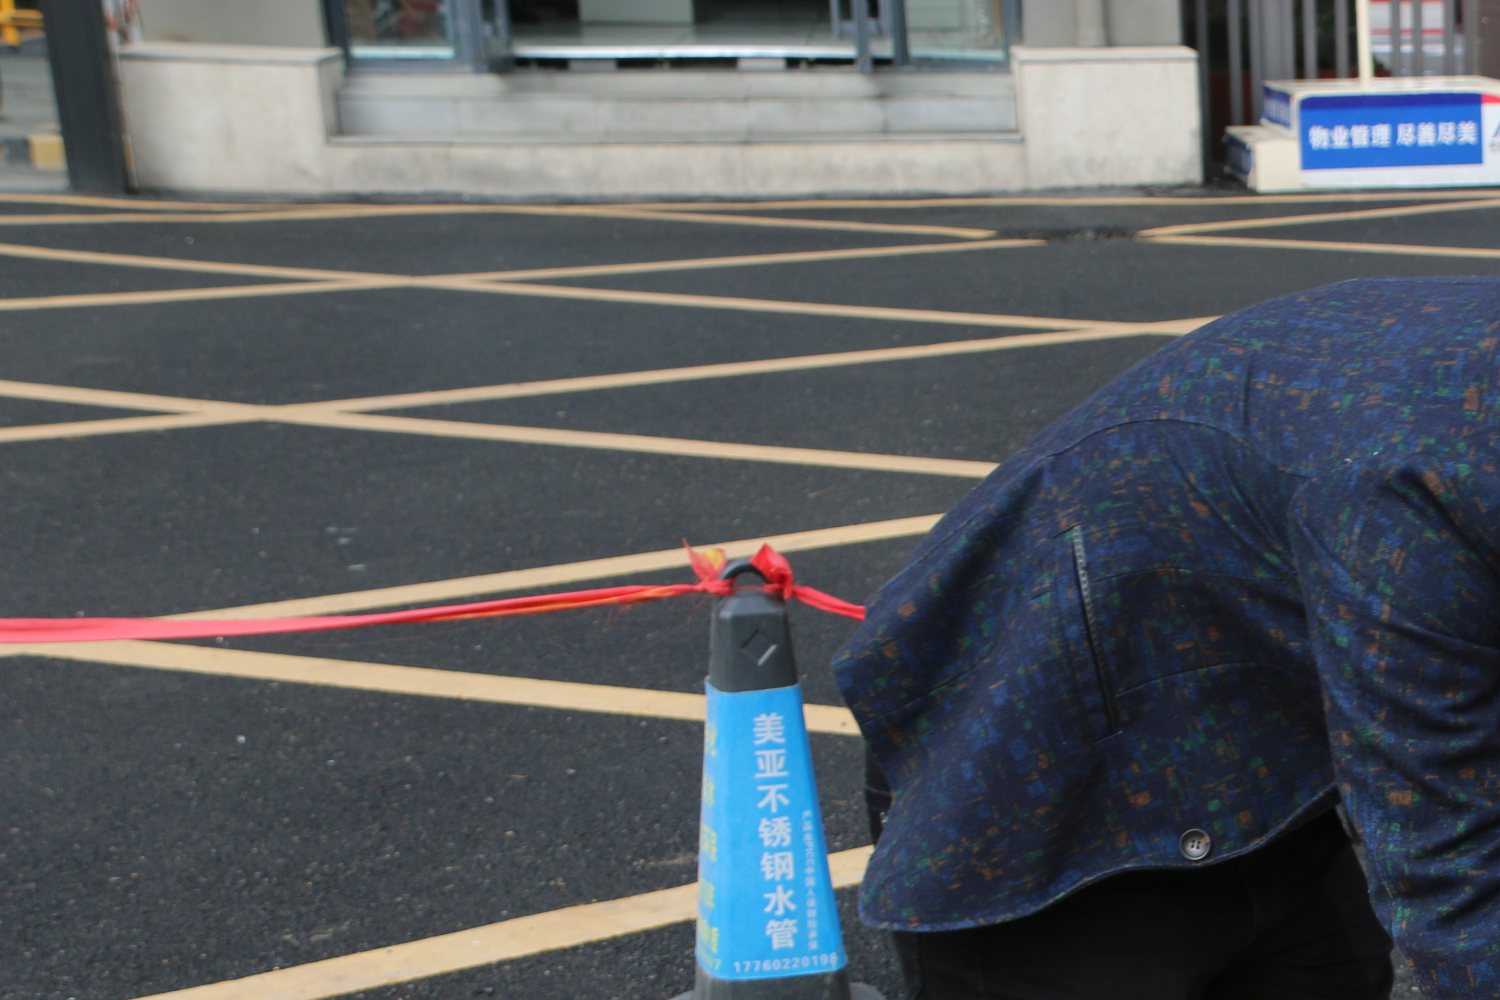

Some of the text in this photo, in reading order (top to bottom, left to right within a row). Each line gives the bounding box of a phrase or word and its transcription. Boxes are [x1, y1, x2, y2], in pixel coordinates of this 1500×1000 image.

[1308, 125, 1391, 149] 物业管理
[1397, 120, 1478, 147] 尽善尽美
[752, 712, 798, 949] 美亚不锈钢水管
